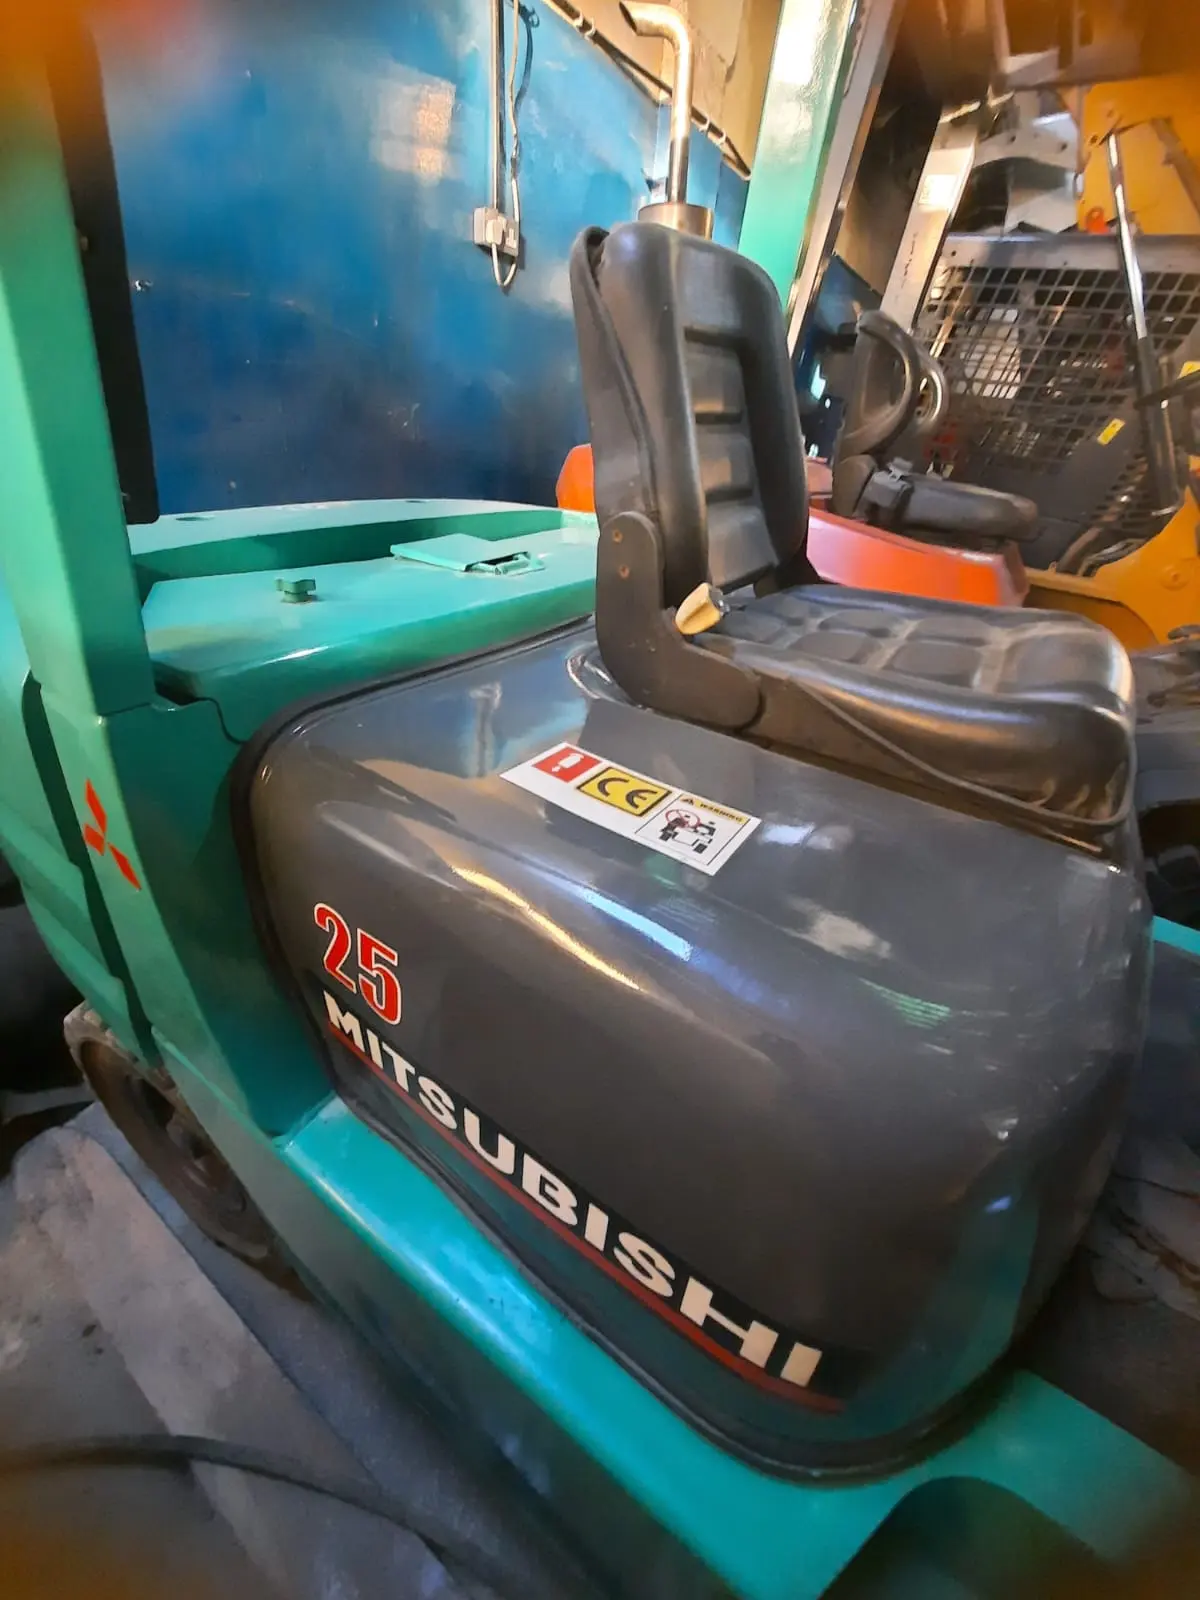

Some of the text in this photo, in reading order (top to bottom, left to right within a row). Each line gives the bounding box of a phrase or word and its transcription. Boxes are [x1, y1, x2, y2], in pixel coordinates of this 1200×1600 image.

[597, 776, 658, 809] CE
[314, 903, 401, 1025] 25
[323, 990, 822, 1387] MITSUBISHI
